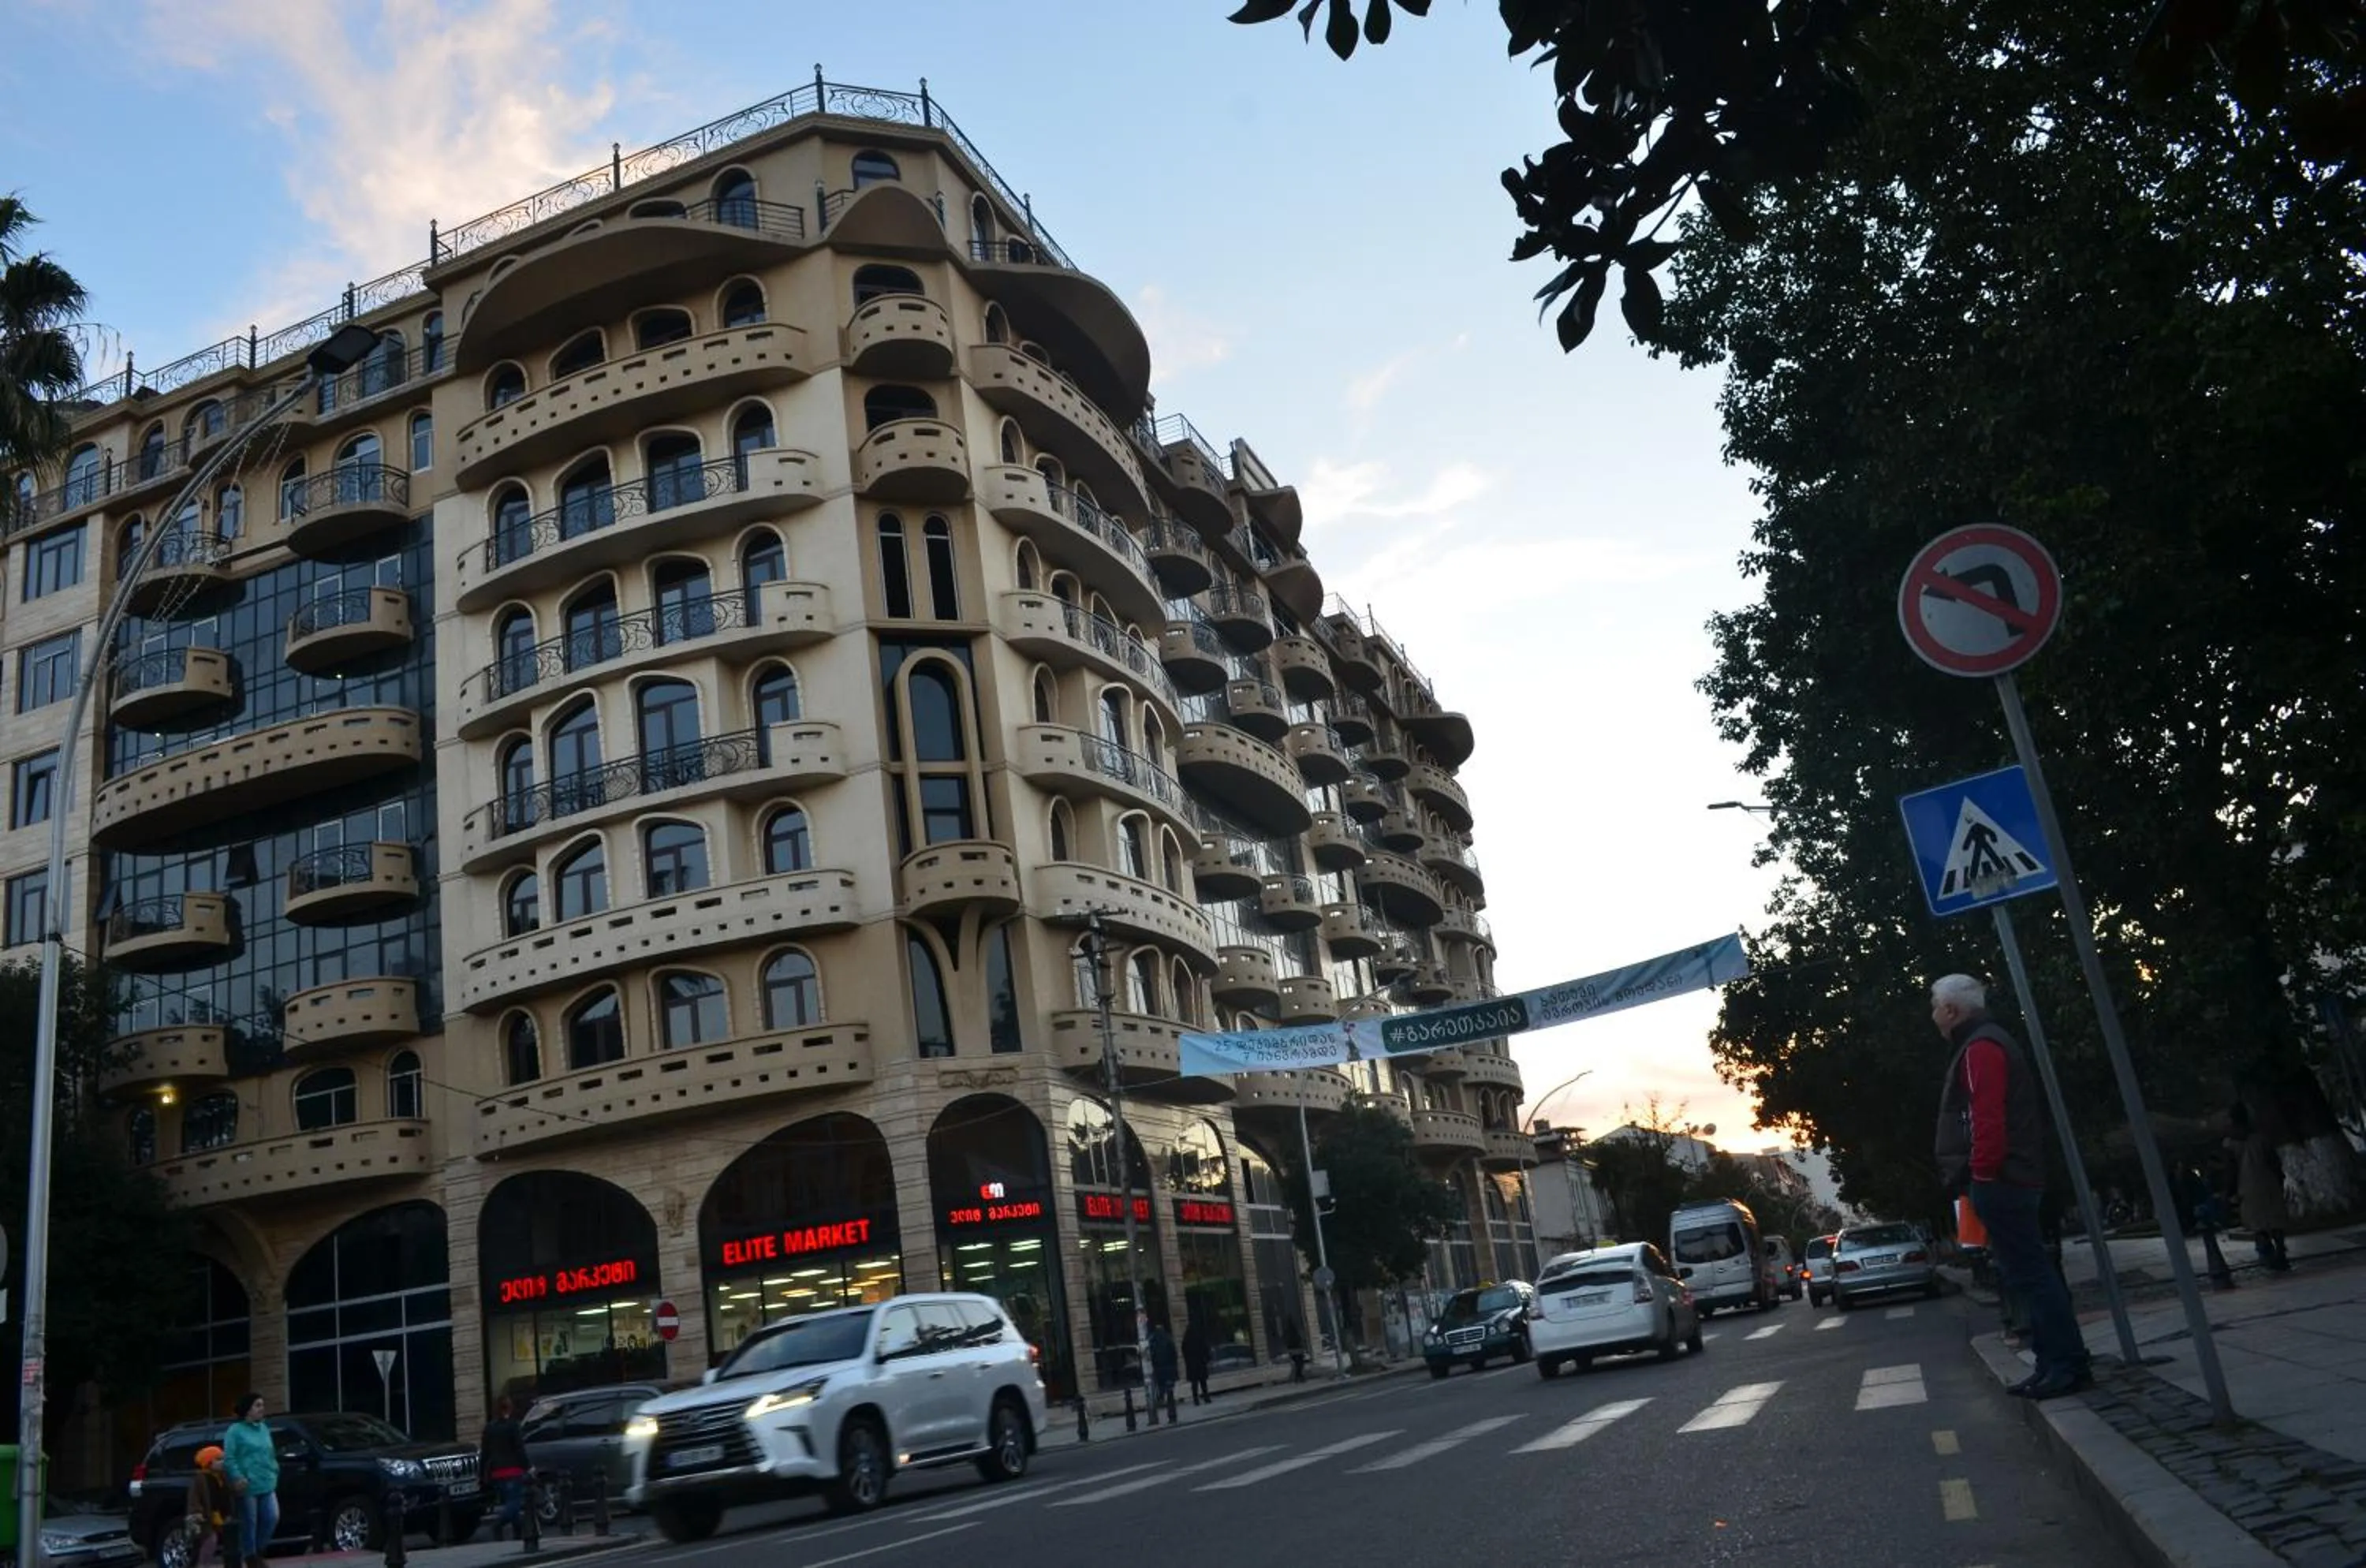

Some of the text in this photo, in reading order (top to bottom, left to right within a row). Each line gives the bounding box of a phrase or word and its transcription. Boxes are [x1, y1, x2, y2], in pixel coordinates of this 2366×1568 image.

[1215, 1039, 1232, 1052] 25
[722, 1219, 870, 1266] ELITE MARKET
[556, 1260, 636, 1294] მარკეტი
